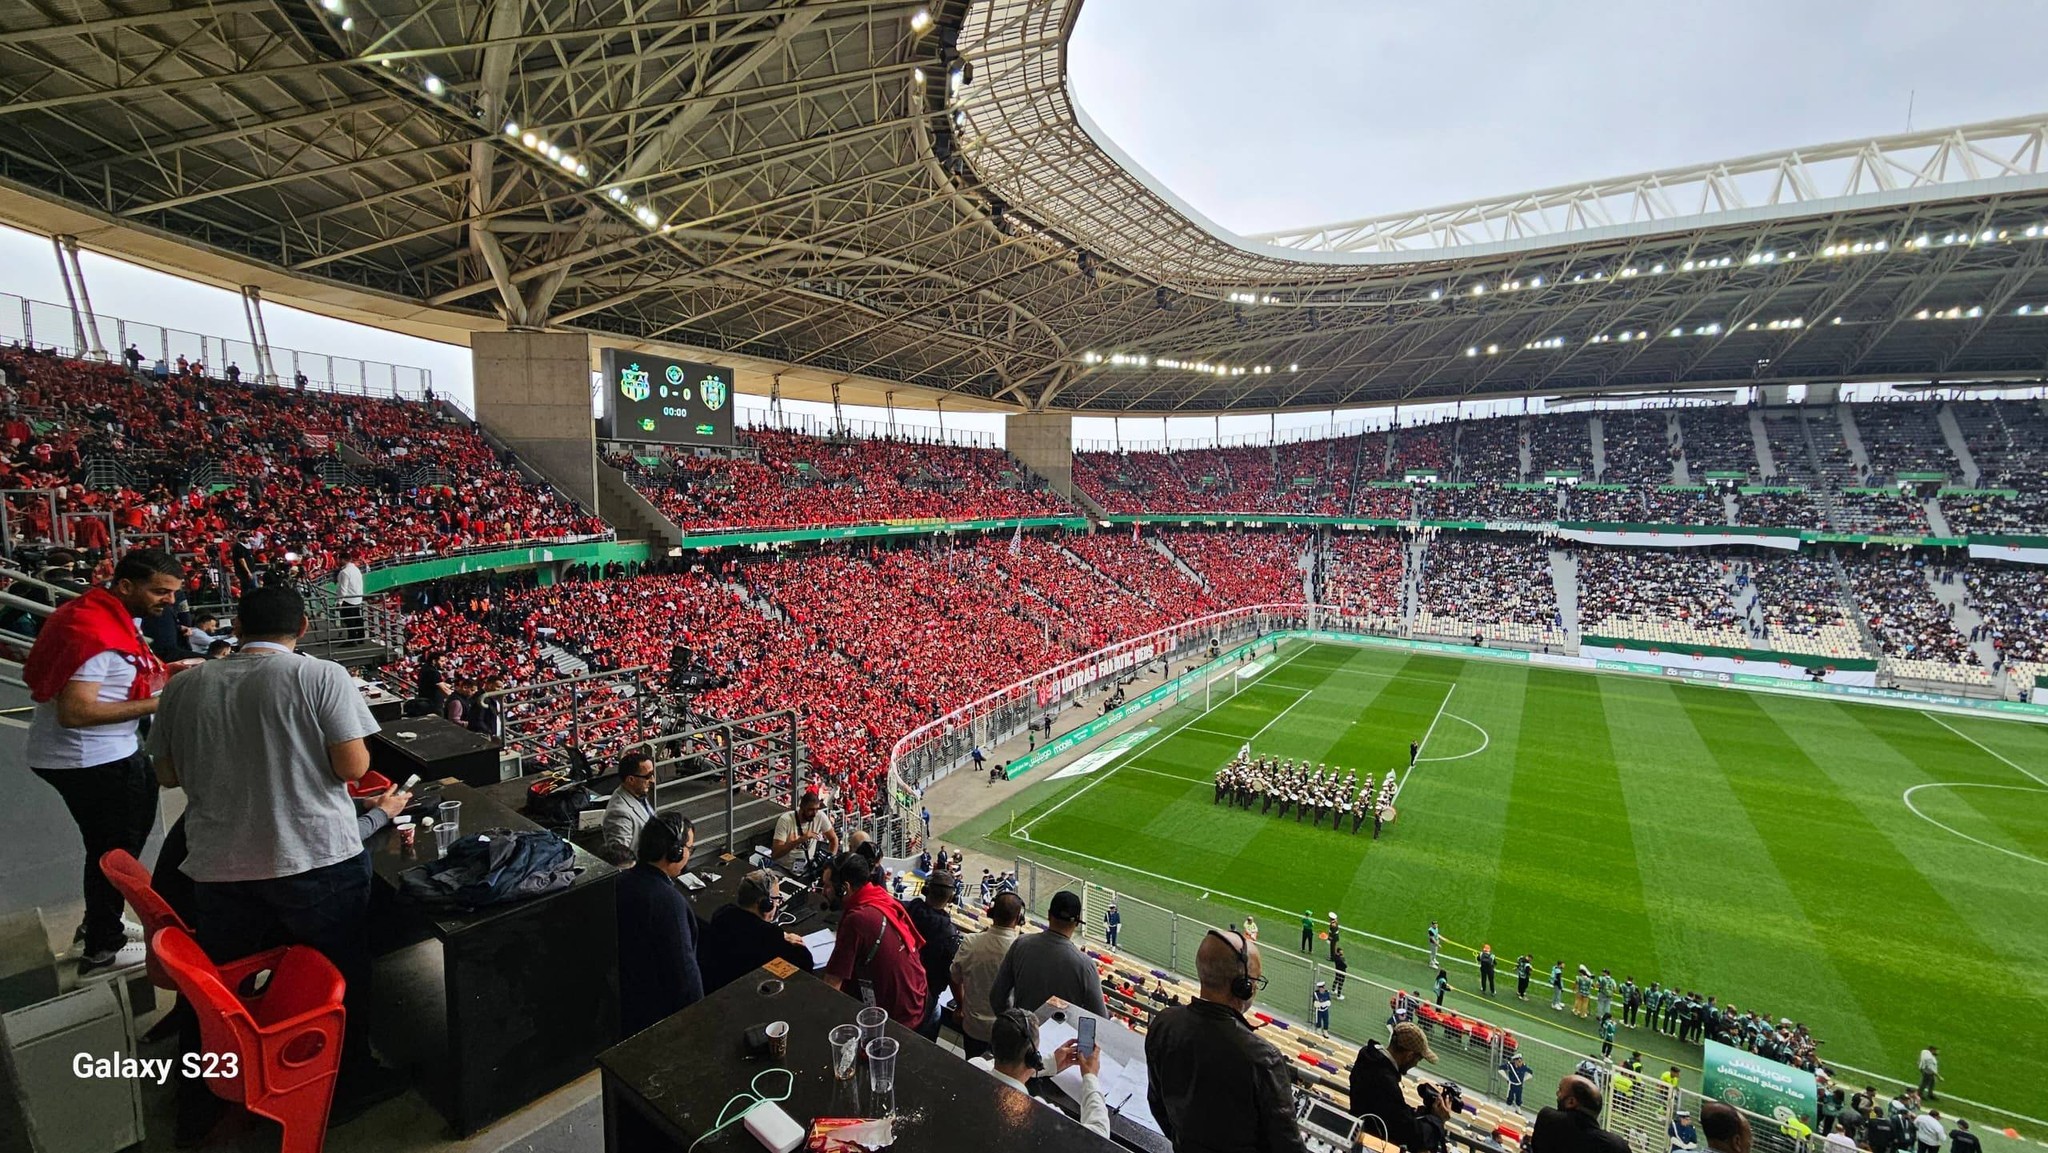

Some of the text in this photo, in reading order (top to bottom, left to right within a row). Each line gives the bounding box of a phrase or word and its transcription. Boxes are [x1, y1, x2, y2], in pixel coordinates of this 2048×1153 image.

[659, 385, 669, 398] 0
[682, 388, 692, 401] 0
[663, 406, 687, 417] 00:00
[1484, 521, 1560, 532] NELSON MANDEL
[1061, 665, 1097, 694] ULTRAS
[1098, 652, 1133, 678] FANATIC
[1717, 1065, 1760, 1084] المستقبل
[1728, 1059, 1793, 1083] موبيليس
